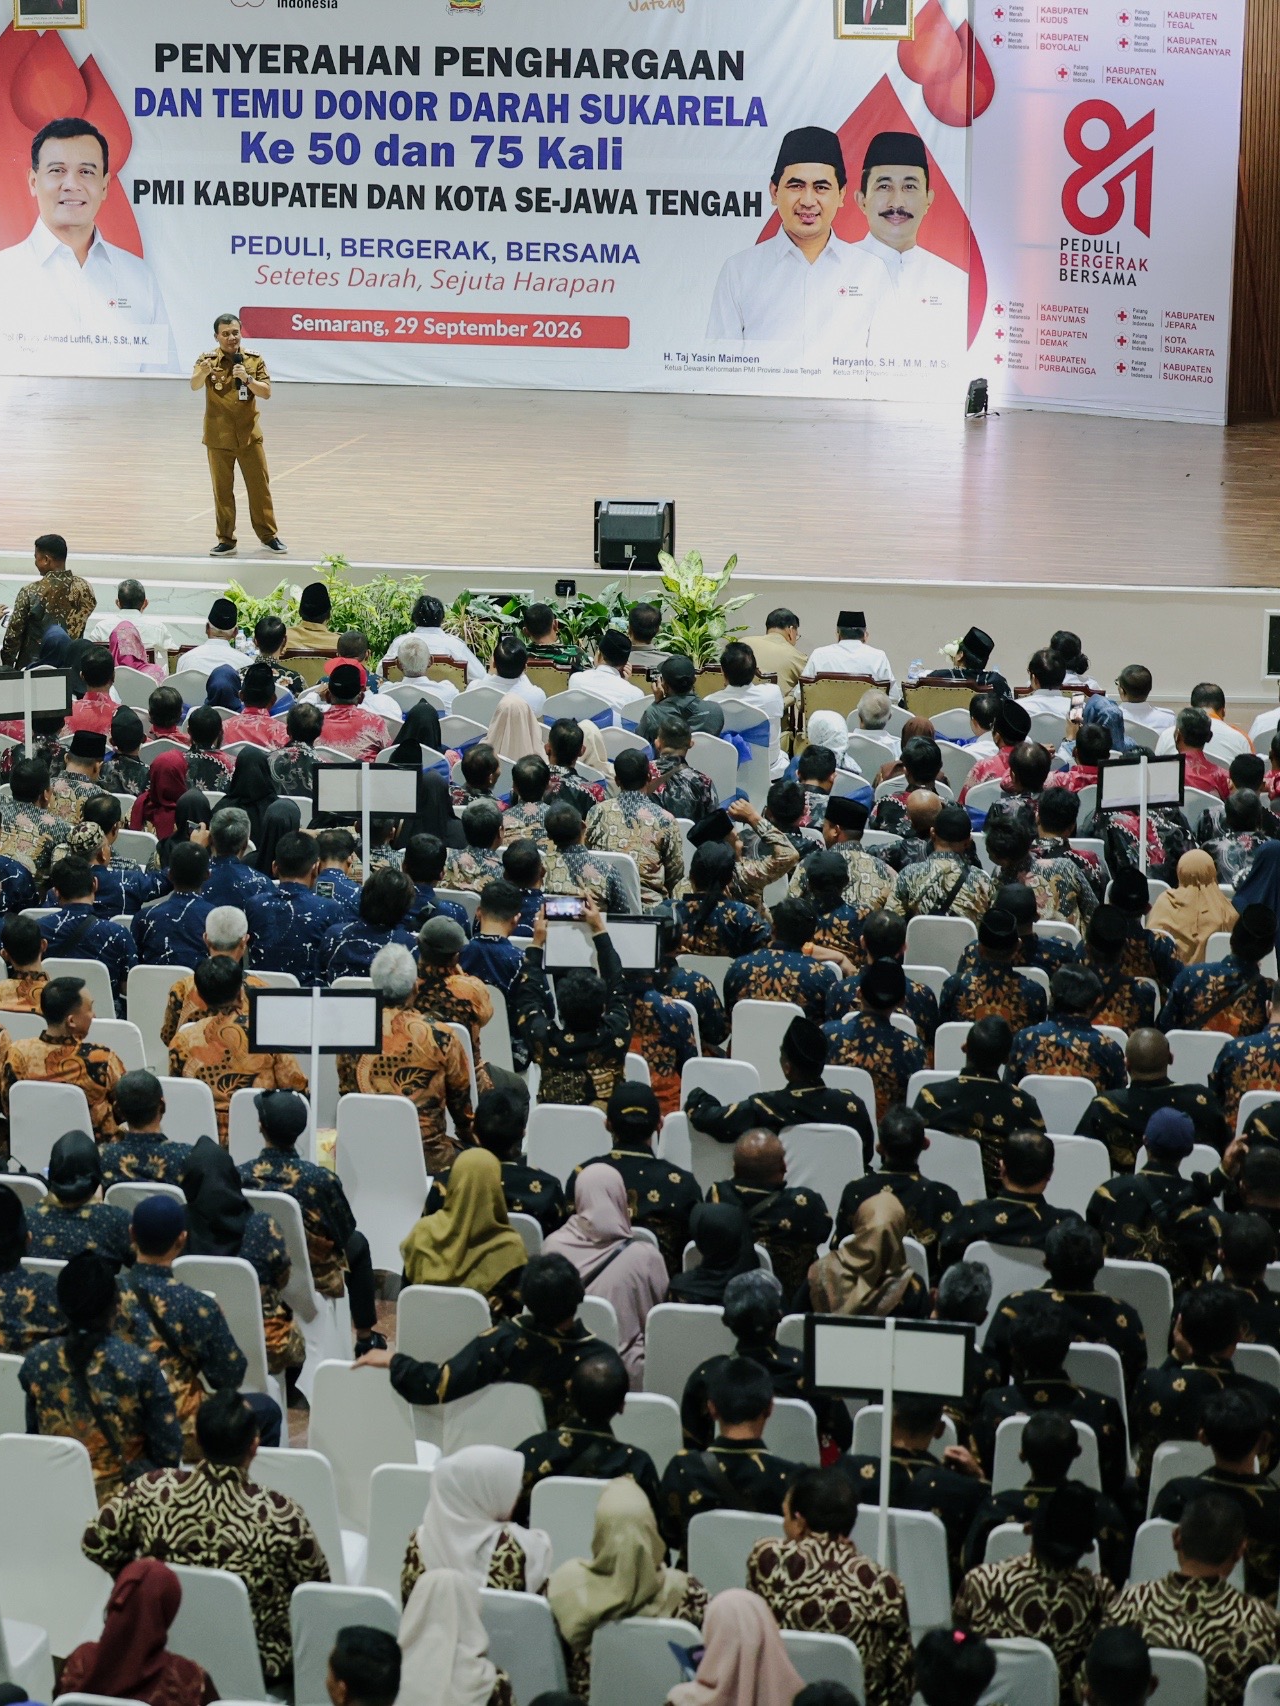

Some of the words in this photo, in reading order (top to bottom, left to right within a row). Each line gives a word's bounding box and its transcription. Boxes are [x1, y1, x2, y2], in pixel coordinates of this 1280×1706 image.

[1040, 7, 1089, 15] KABUPATEN
[1167, 11, 1218, 20] KABUPATEN
[1167, 21, 1195, 29] TEGAL
[1040, 33, 1089, 42] KABUPATEN
[1167, 36, 1217, 45] KABUPATEN
[1040, 43, 1081, 51] BOYOLALI
[1166, 47, 1231, 56] KARANGANYAR
[155, 43, 421, 76] PENYERAHAN
[434, 46, 744, 81] PENGHARGAAN
[1106, 66, 1157, 75] KABUPATEN
[1106, 76, 1165, 86] PEKALONGAN
[134, 87, 202, 117] DAN
[213, 88, 303, 119] TEMU
[315, 89, 438, 121] DONOR
[450, 91, 569, 123] DARAH
[579, 93, 768, 127] SUKARELA
[240, 131, 295, 164] Ke
[307, 132, 361, 166] 50
[374, 133, 455, 167] dan
[470, 135, 524, 169] 75
[538, 136, 623, 170] Kali
[133, 179, 184, 205] PMI
[194, 180, 357, 208] KABUPATEN
[367, 184, 425, 210] DAN
[435, 185, 507, 212] KOTA
[514, 187, 638, 215] SE-JAWA
[646, 189, 762, 218] TENGAH
[231, 235, 331, 260] PEDULI,
[341, 237, 497, 264] BERGERAK,
[506, 241, 641, 264] BERSAMA
[1060, 237, 1120, 254] PEDULI
[1060, 252, 1148, 272] BERGERAK
[255, 264, 340, 287] Setetes
[347, 267, 423, 292] Darah,
[430, 269, 505, 296] Sejuta
[513, 271, 616, 298] Harapan
[1059, 268, 1137, 287] BERSAMA
[1040, 304, 1089, 314] KABUPATEN
[1040, 314, 1086, 324] BANYUMAS
[1165, 311, 1215, 321] KABUPATEN
[291, 313, 390, 336] Semarang,
[394, 316, 419, 335] 29
[423, 317, 529, 338] September
[532, 320, 583, 339] 2026
[1165, 321, 1197, 330] JEPARA
[1040, 329, 1088, 339] KABUPATEN
[1040, 339, 1068, 347] DEMAK
[1164, 336, 1187, 344] KOTA
[1164, 346, 1215, 357] SURAKARTA
[663, 352, 673, 361] H.
[676, 352, 689, 363] Taj
[691, 353, 716, 362] Yasin
[718, 353, 760, 364] Maimoen
[1039, 354, 1087, 364] KABUPATEN
[683, 364, 704, 372] Dewan
[705, 365, 742, 373] Kehormatan
[757, 366, 781, 374] Provinsi
[800, 367, 822, 375] Tengah
[1039, 364, 1097, 375] PURBALINGGA
[1163, 363, 1212, 373] KABUPATEN
[1163, 373, 1214, 383] SUKOHARJO
